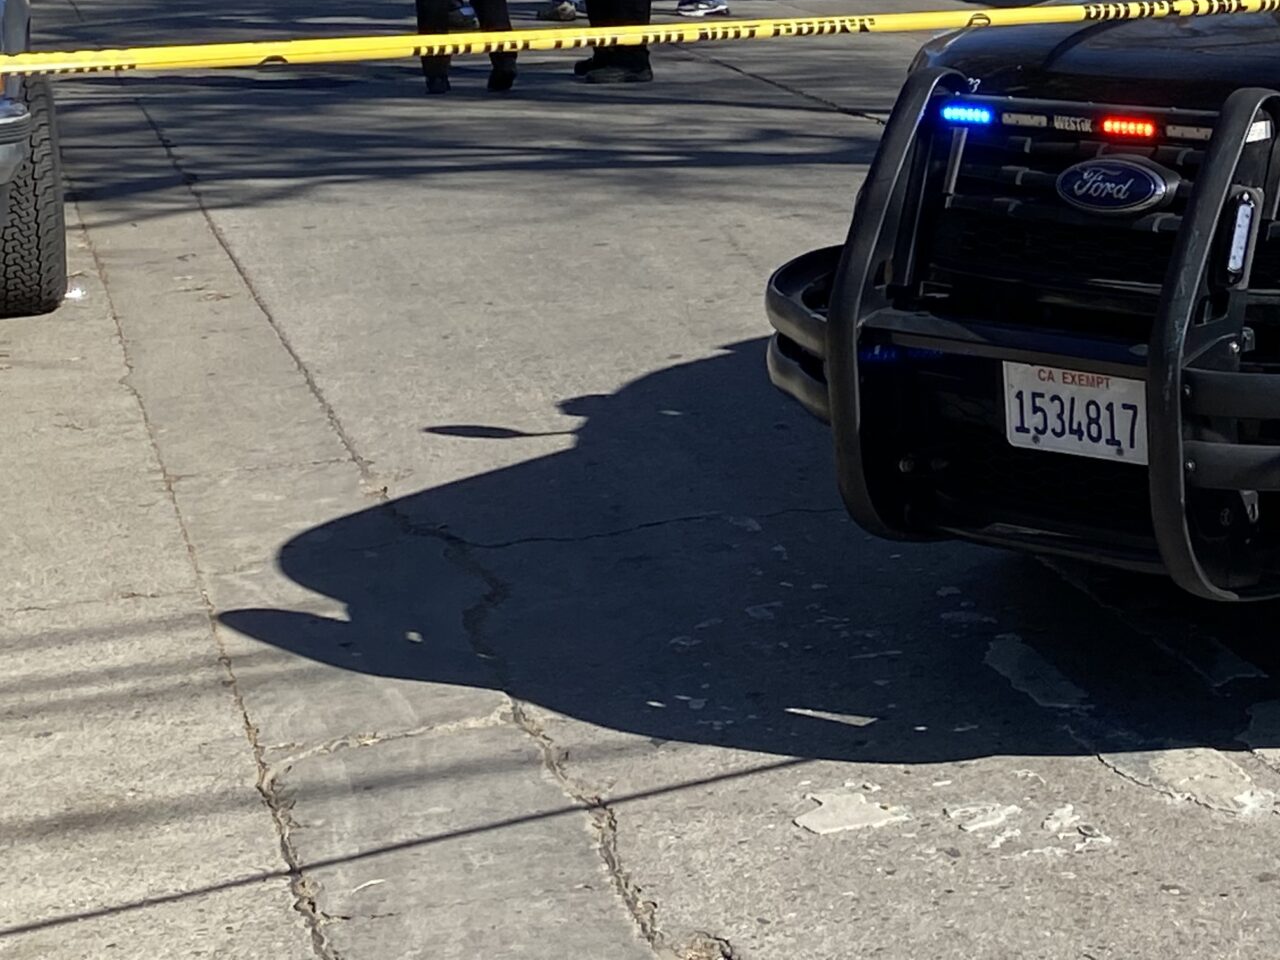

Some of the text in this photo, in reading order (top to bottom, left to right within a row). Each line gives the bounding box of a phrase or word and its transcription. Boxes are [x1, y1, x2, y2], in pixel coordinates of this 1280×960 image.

[1074, 167, 1135, 200] Ford
[1037, 368, 1112, 390] CA EXEMPT
[1014, 389, 1139, 450] 1534817
